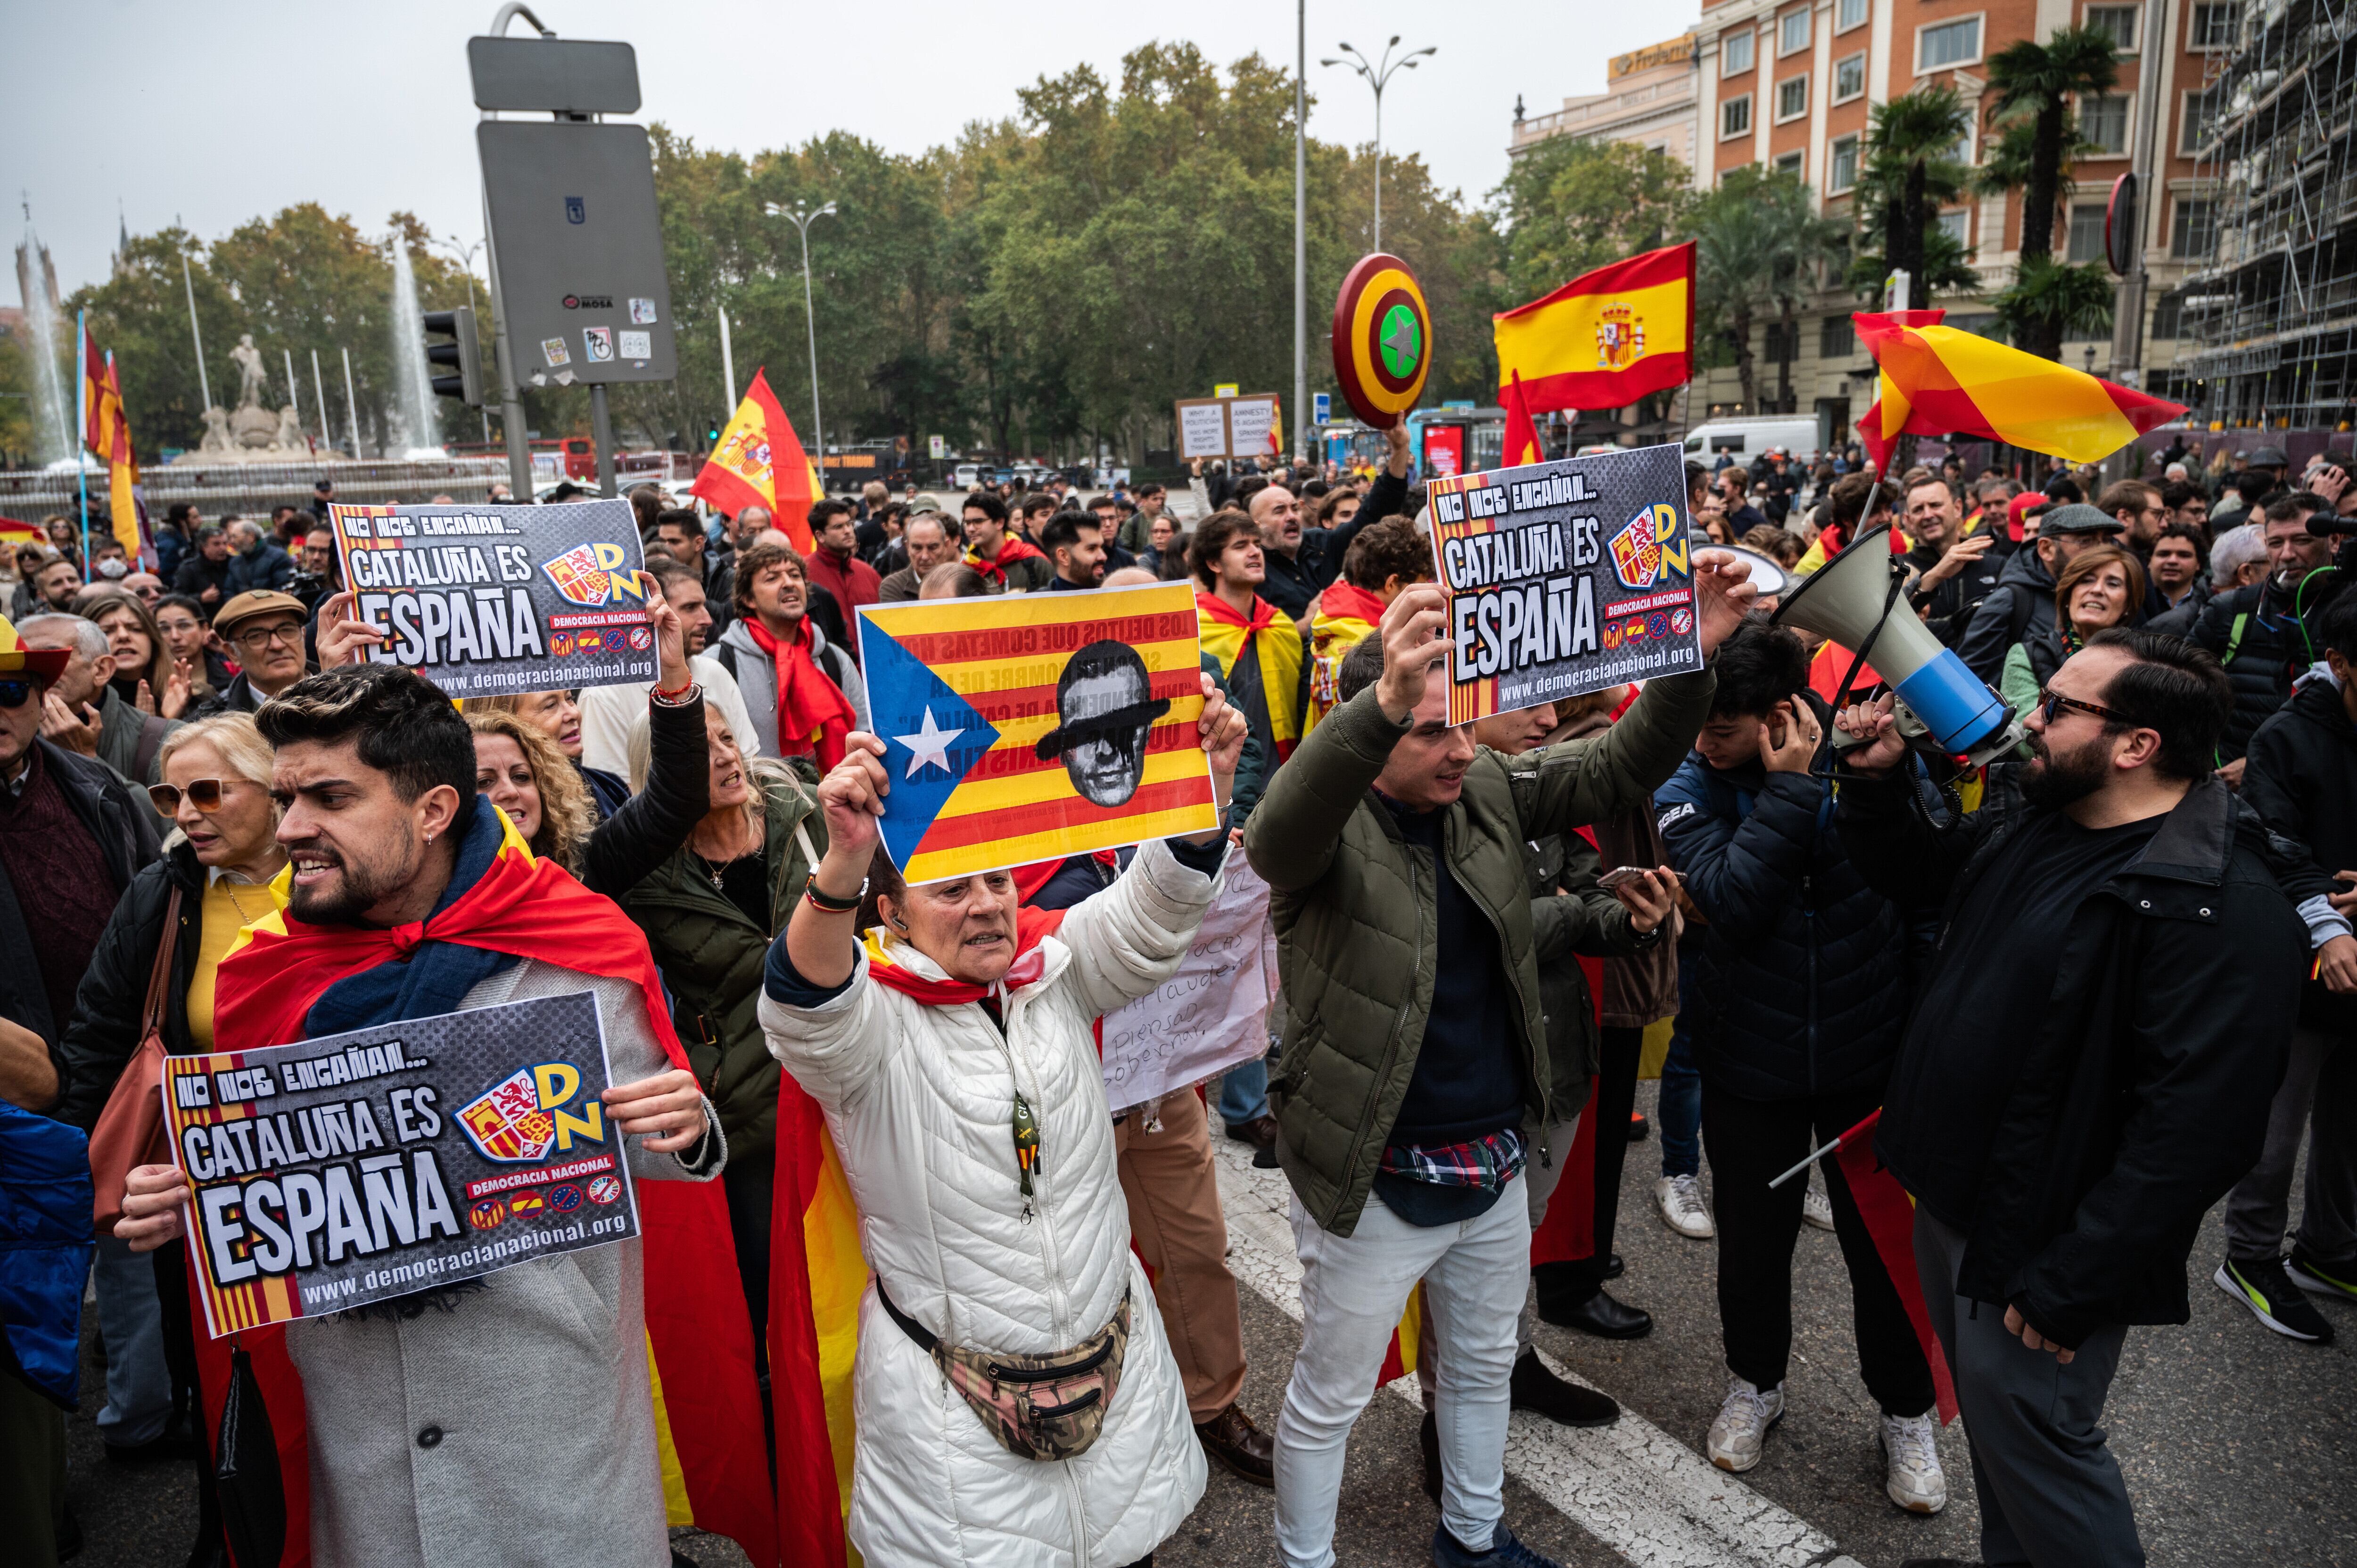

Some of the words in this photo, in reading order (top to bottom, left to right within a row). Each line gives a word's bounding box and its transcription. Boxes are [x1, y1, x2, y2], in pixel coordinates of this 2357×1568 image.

[344, 517, 371, 537] NO
[376, 516, 416, 536] NOS
[421, 513, 520, 535] ENGAÑAN...
[1437, 494, 1464, 523] NO
[1469, 487, 1508, 517] NOS
[1512, 475, 1597, 510] ENGAÑAN...
[351, 546, 491, 587] CATALUÑA
[494, 545, 532, 582] ES
[1445, 524, 1565, 589] CATALUÑA
[1573, 517, 1599, 566] ES
[361, 588, 544, 665] ESPAÑA
[554, 615, 606, 627] DEMOCRACIA
[607, 612, 647, 623] NACIONAL
[1455, 575, 1596, 681] ESPAÑA
[1608, 599, 1651, 616] DEMOCRACIA
[1653, 591, 1689, 607] NACIONAL
[431, 662, 651, 690] www.democracianacional.org
[1501, 647, 1693, 702] www.democracianacional.org
[176, 1076, 210, 1108] NO
[216, 1068, 275, 1102] NOS
[281, 1042, 428, 1091] ENGAÑAN...
[184, 1101, 384, 1179] CATALUÑA
[390, 1087, 441, 1142] ES
[472, 1170, 549, 1196] DEMOCRACIA
[552, 1158, 611, 1180] NACIONAL
[201, 1151, 461, 1283] ESPAÑA
[305, 1215, 626, 1304] www.democracianacional.org
